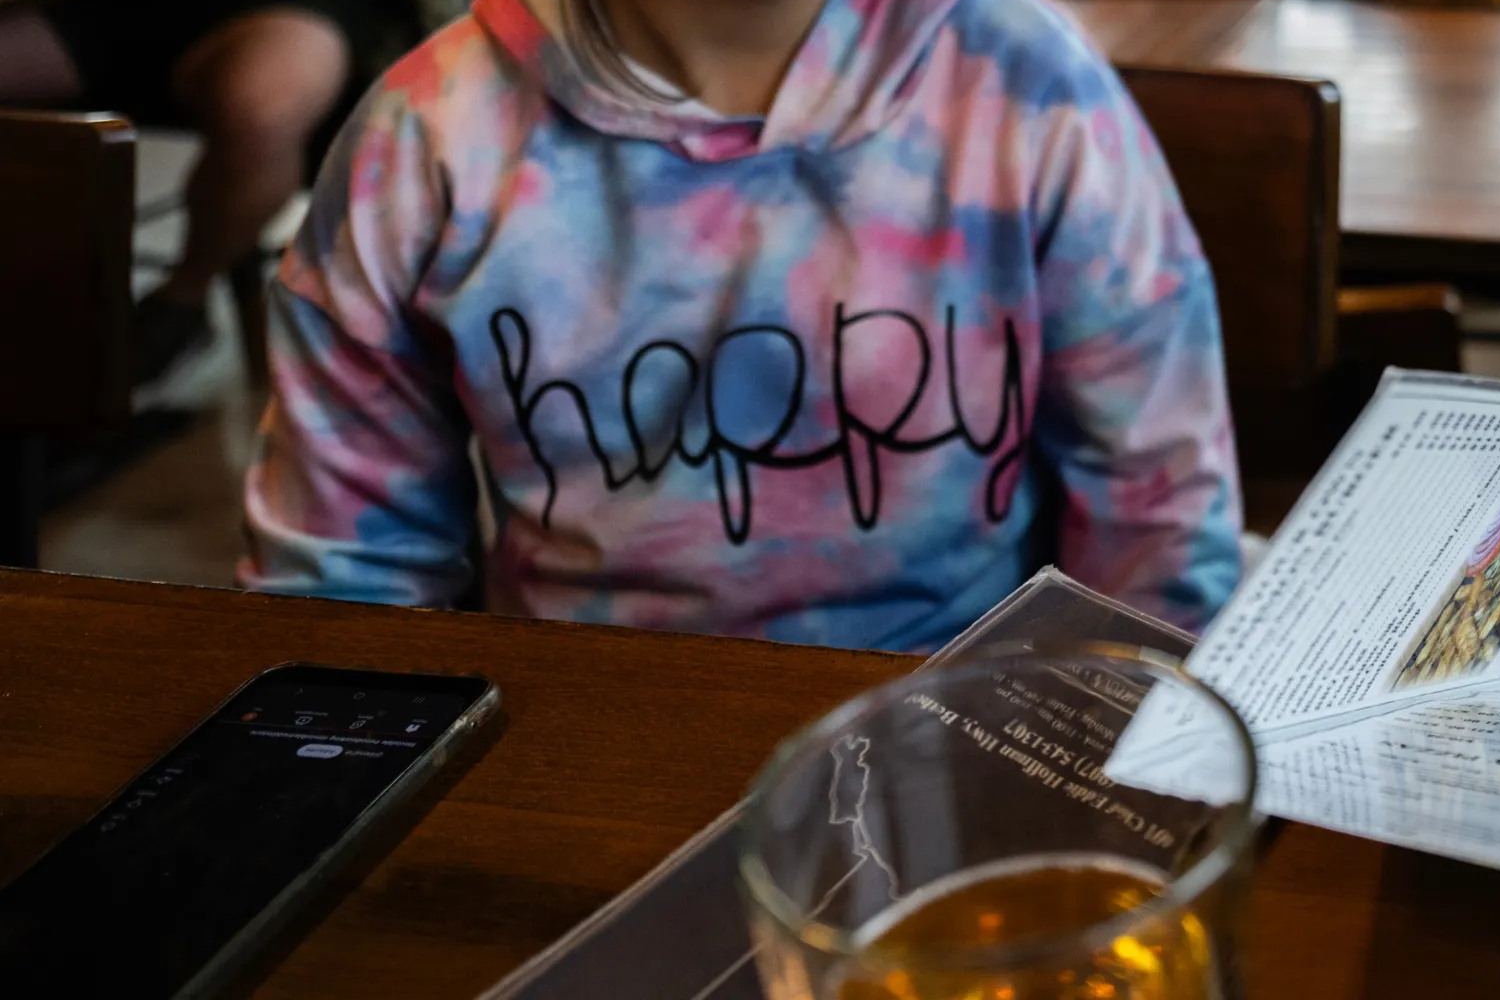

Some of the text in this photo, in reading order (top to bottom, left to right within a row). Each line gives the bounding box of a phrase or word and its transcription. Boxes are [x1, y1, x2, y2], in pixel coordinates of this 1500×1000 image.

[489, 302, 1026, 545] happy
[961, 717, 1000, 753] Hwy,
[1002, 717, 1077, 766] 543-1307
[999, 744, 1065, 789] Hoffman
